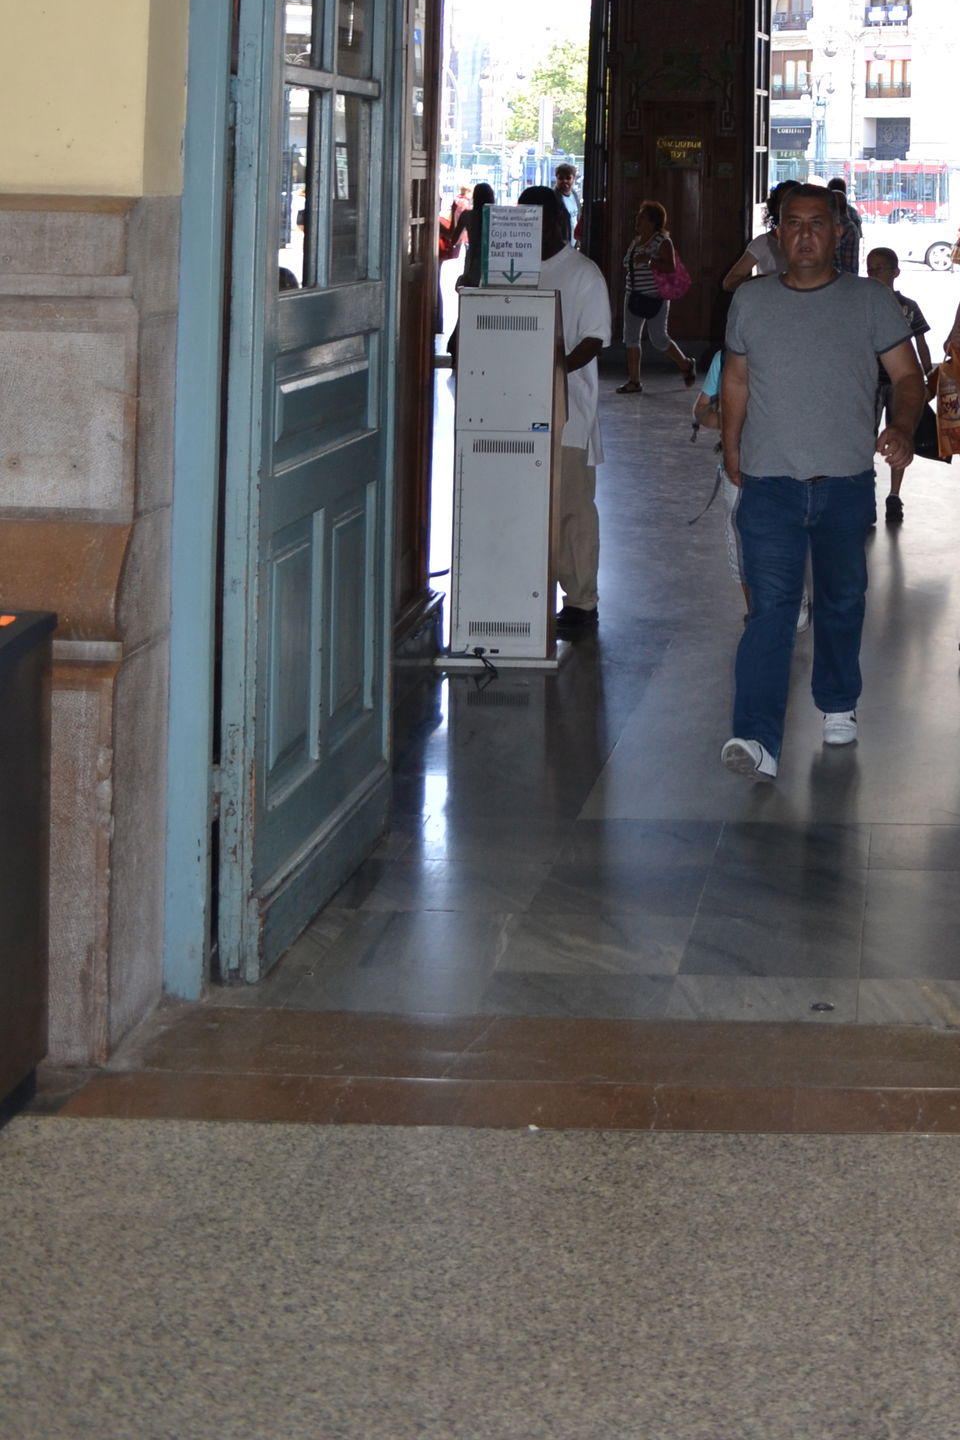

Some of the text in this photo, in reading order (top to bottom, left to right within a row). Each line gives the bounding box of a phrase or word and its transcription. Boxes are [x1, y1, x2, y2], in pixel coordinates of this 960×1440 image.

[491, 230, 532, 239] Coja turno
[490, 240, 533, 250] Agafe torn
